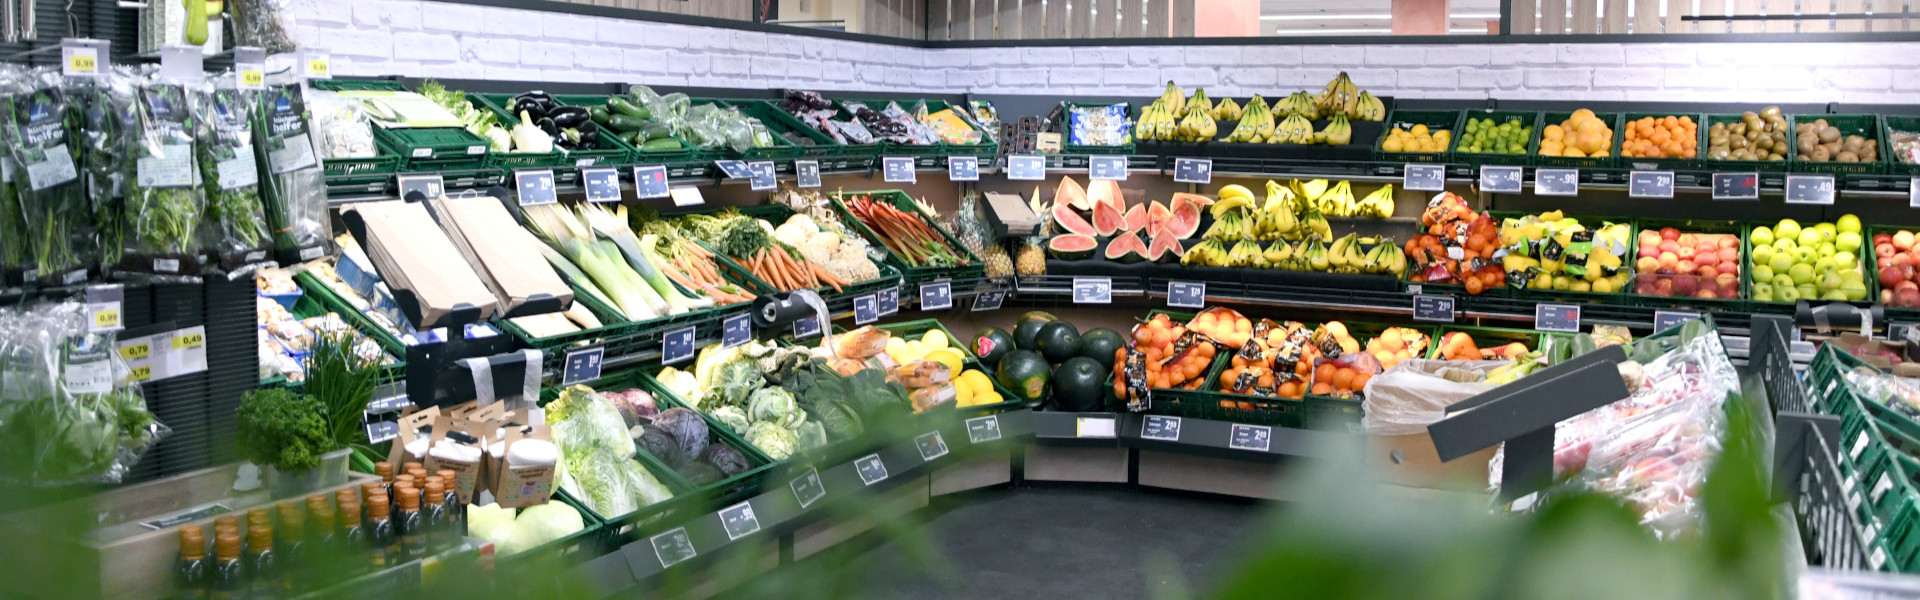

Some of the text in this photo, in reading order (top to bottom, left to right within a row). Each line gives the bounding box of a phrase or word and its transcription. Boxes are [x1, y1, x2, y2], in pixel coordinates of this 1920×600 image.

[76, 59, 95, 68] 0,99
[246, 74, 261, 82] 0,99
[273, 121, 302, 132] helfer
[1427, 170, 1442, 180] -.79
[1504, 172, 1519, 182] -.49
[1559, 174, 1575, 184] -.99
[1813, 182, 1831, 192] -.49
[100, 313, 118, 322] 0,99
[183, 334, 202, 345] 0,49
[129, 344, 148, 355] 0,79
